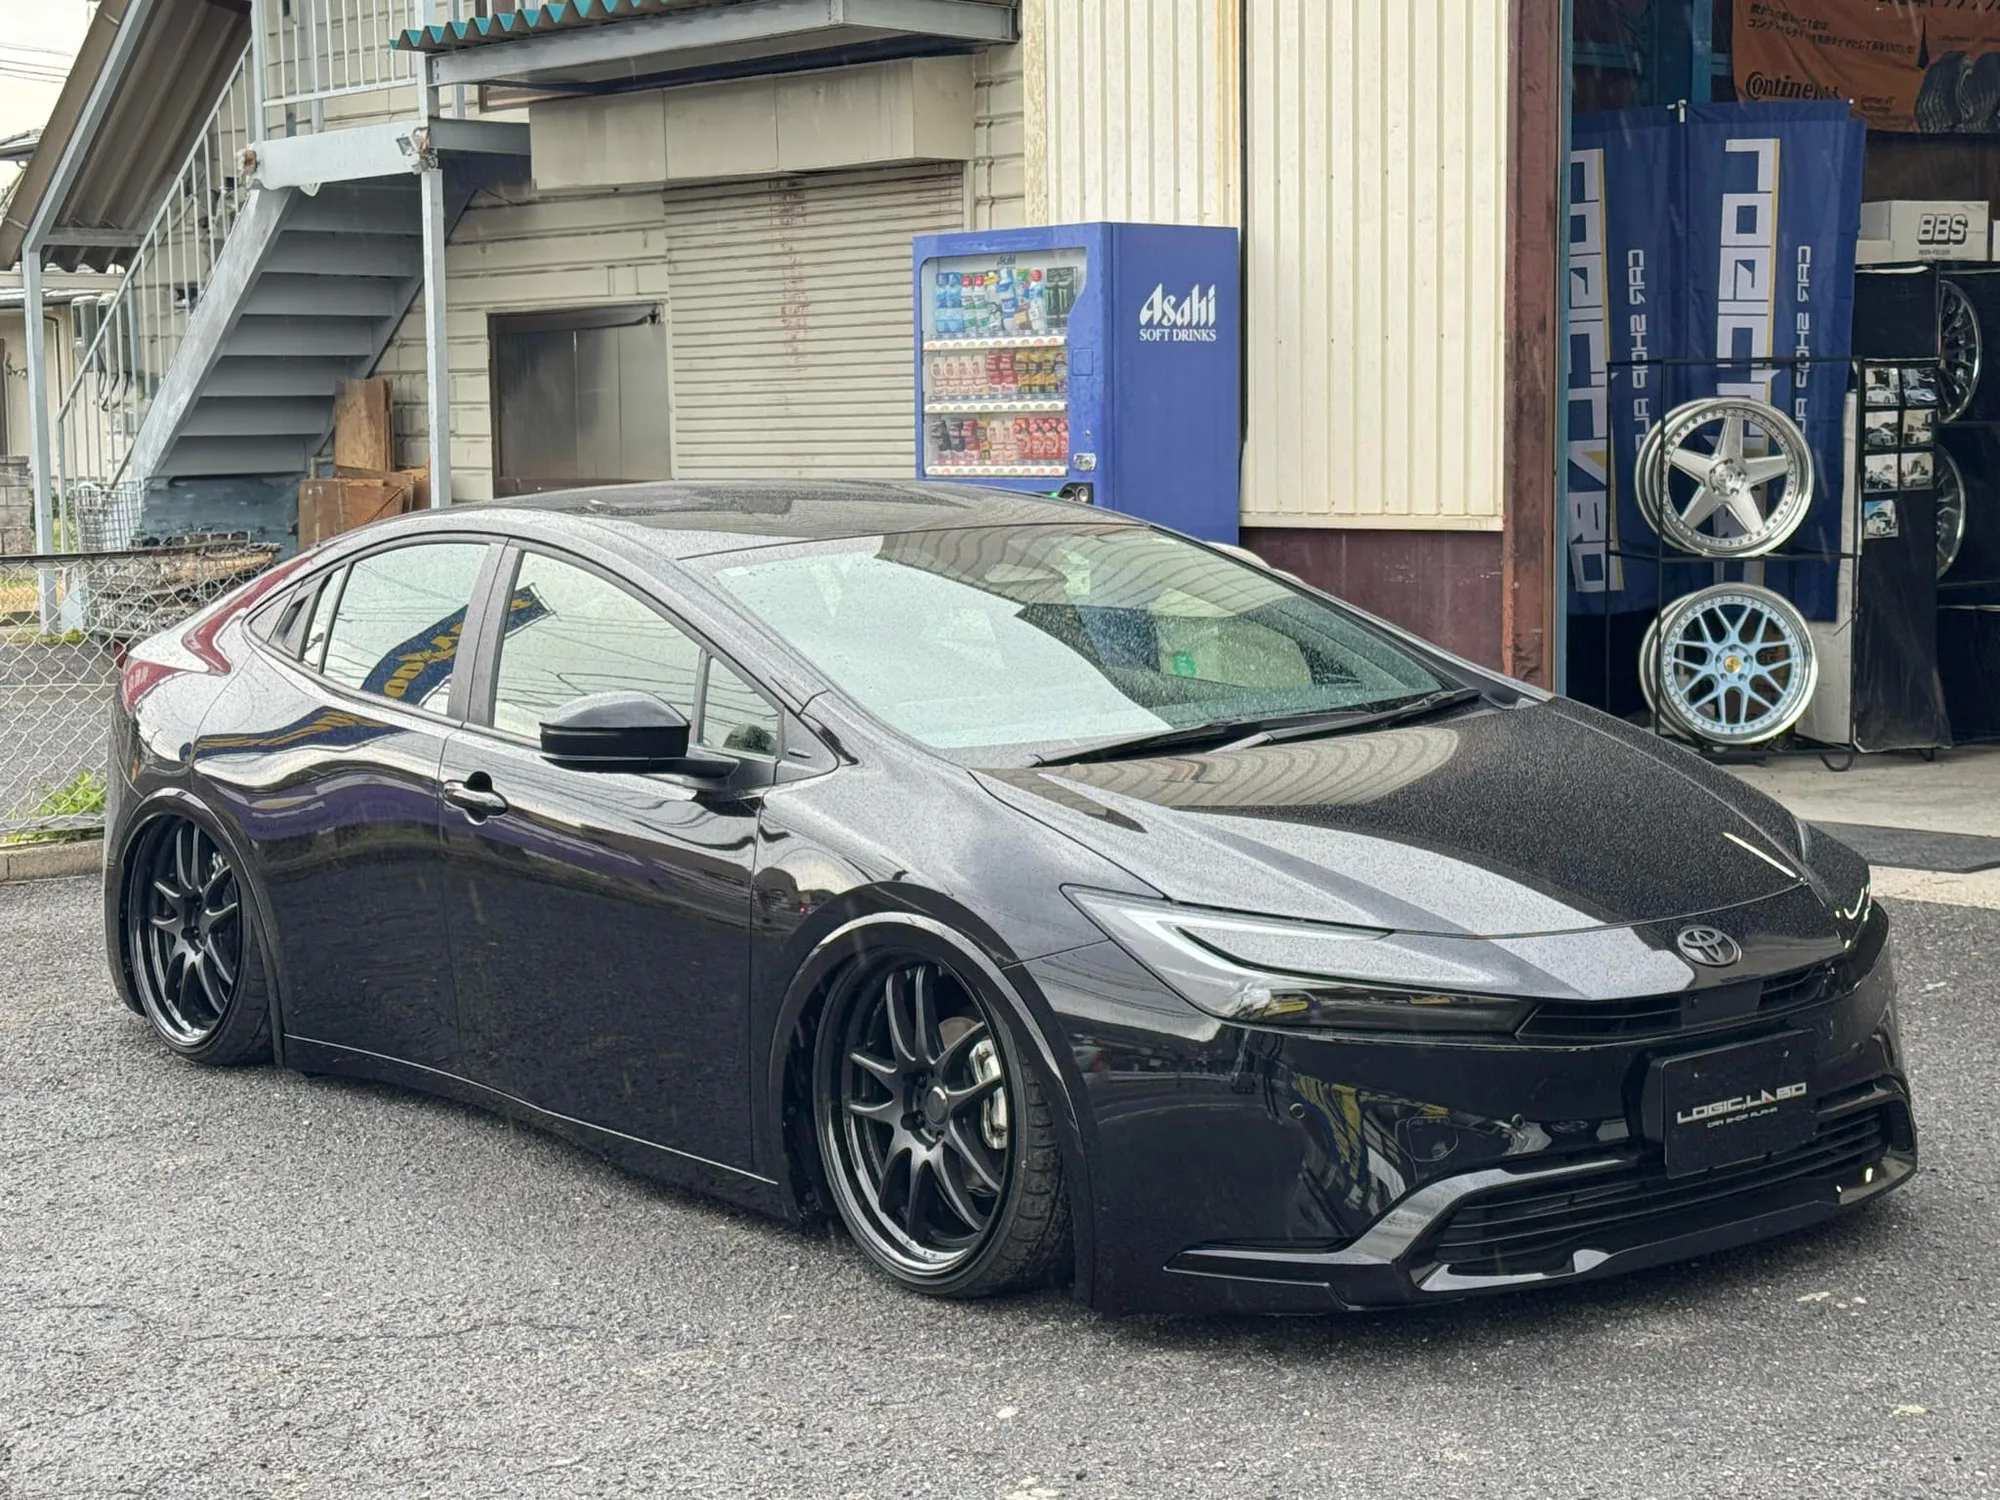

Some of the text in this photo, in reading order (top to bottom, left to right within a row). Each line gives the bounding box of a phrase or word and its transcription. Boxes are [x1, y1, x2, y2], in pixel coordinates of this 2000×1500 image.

[1917, 214, 1968, 245] BBS
[1139, 282, 1216, 327] Asahi
[1140, 329, 1217, 342] SOFT DRINKS
